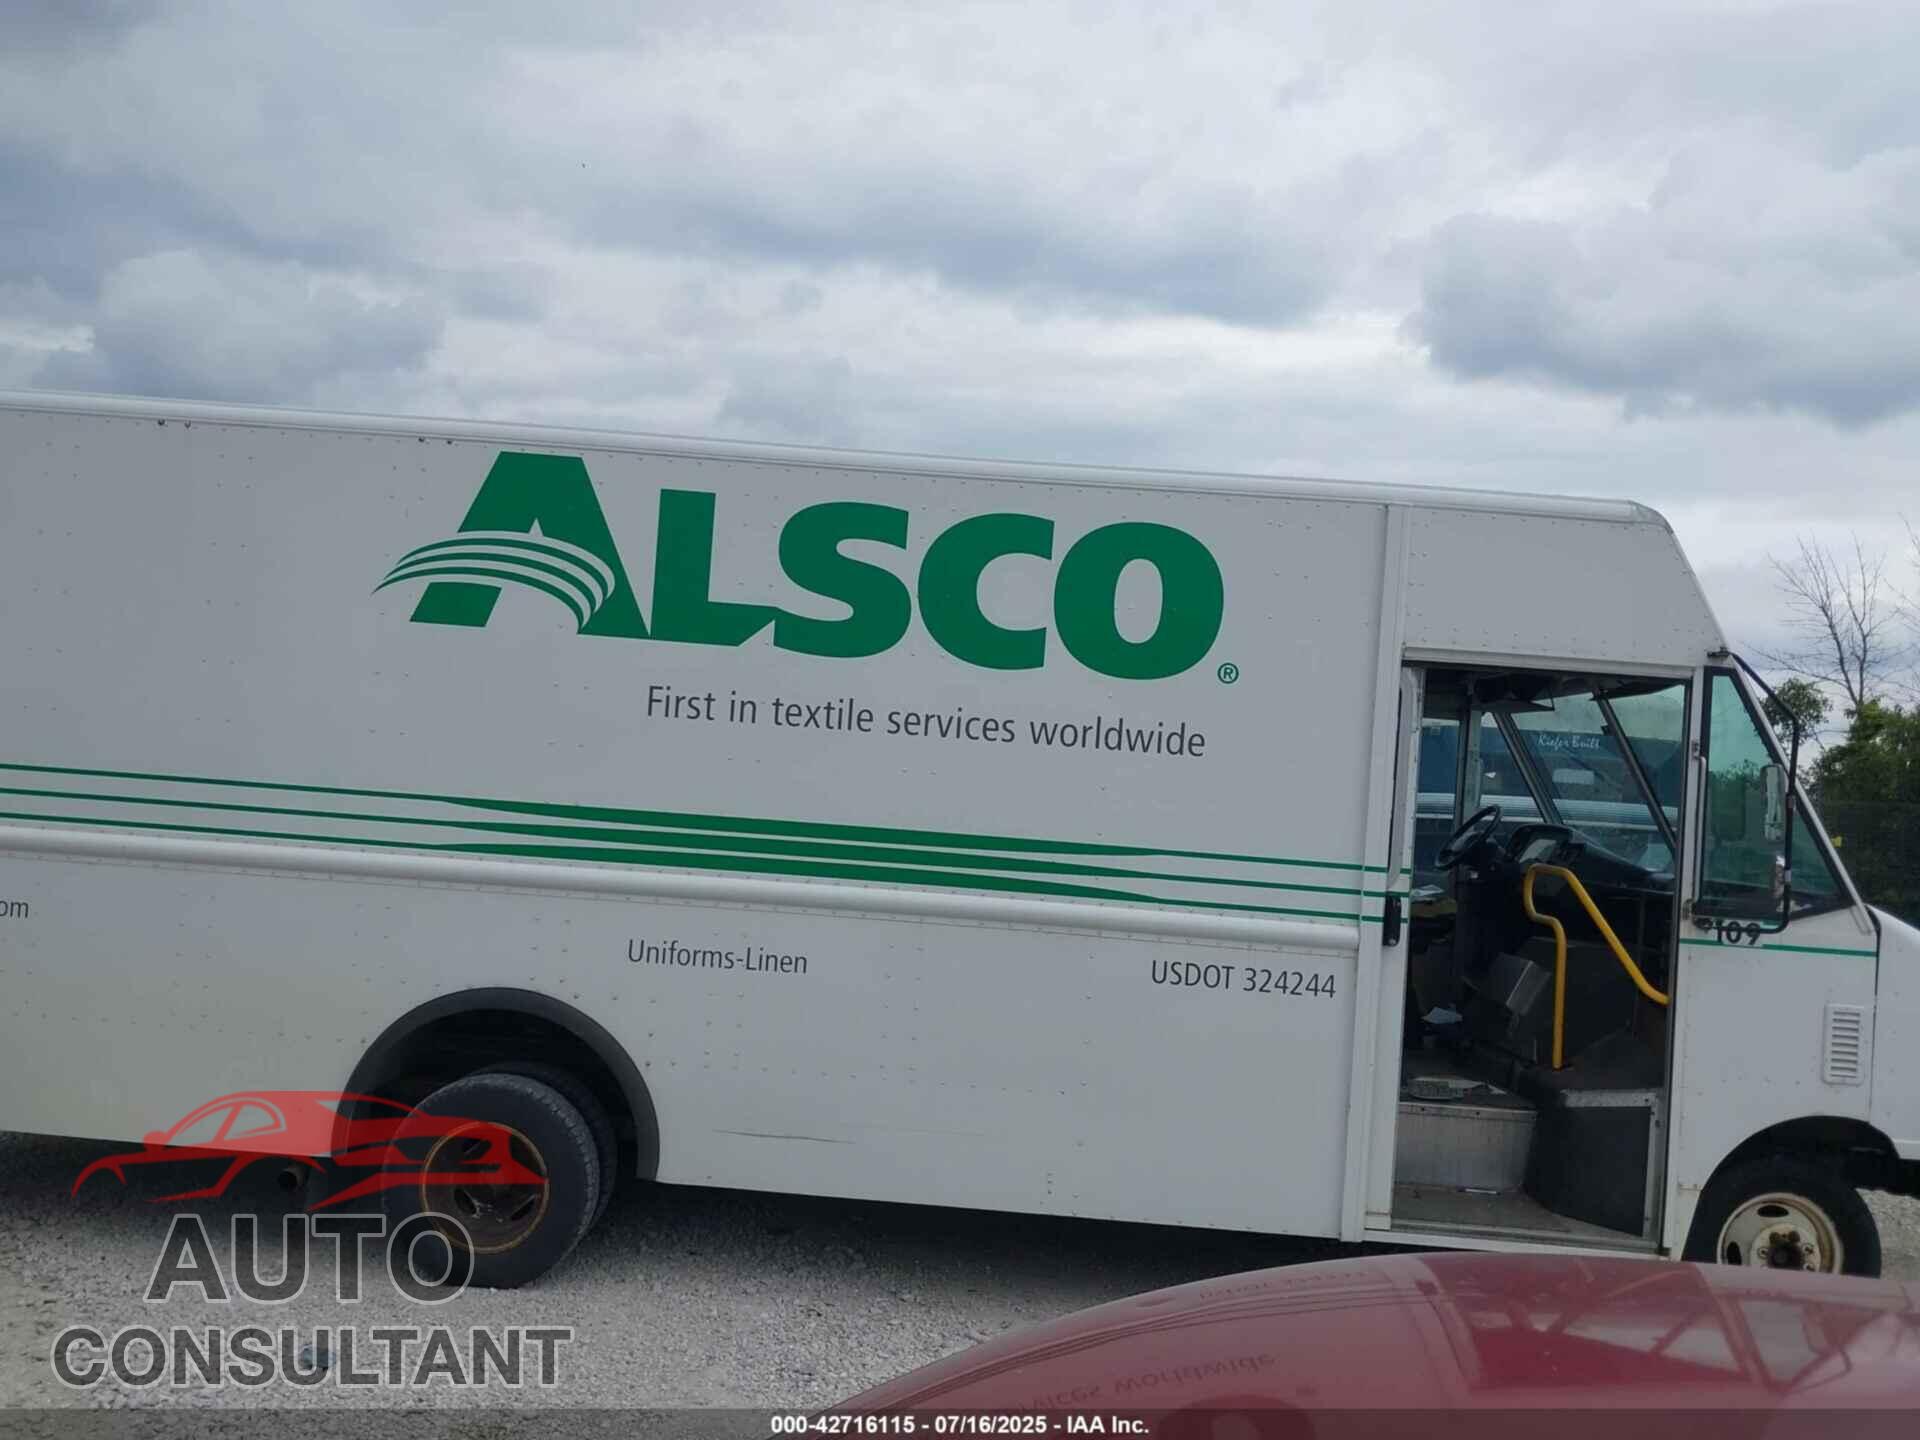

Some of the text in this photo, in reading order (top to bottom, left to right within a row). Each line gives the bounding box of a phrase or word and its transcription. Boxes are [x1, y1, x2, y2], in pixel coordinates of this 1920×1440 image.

[373, 451, 1225, 680] ALSCO
[647, 685, 1206, 757] First in textile services worldwide
[628, 938, 808, 974] Uniforms-Linen
[1151, 959, 1337, 999] USDOT 324244
